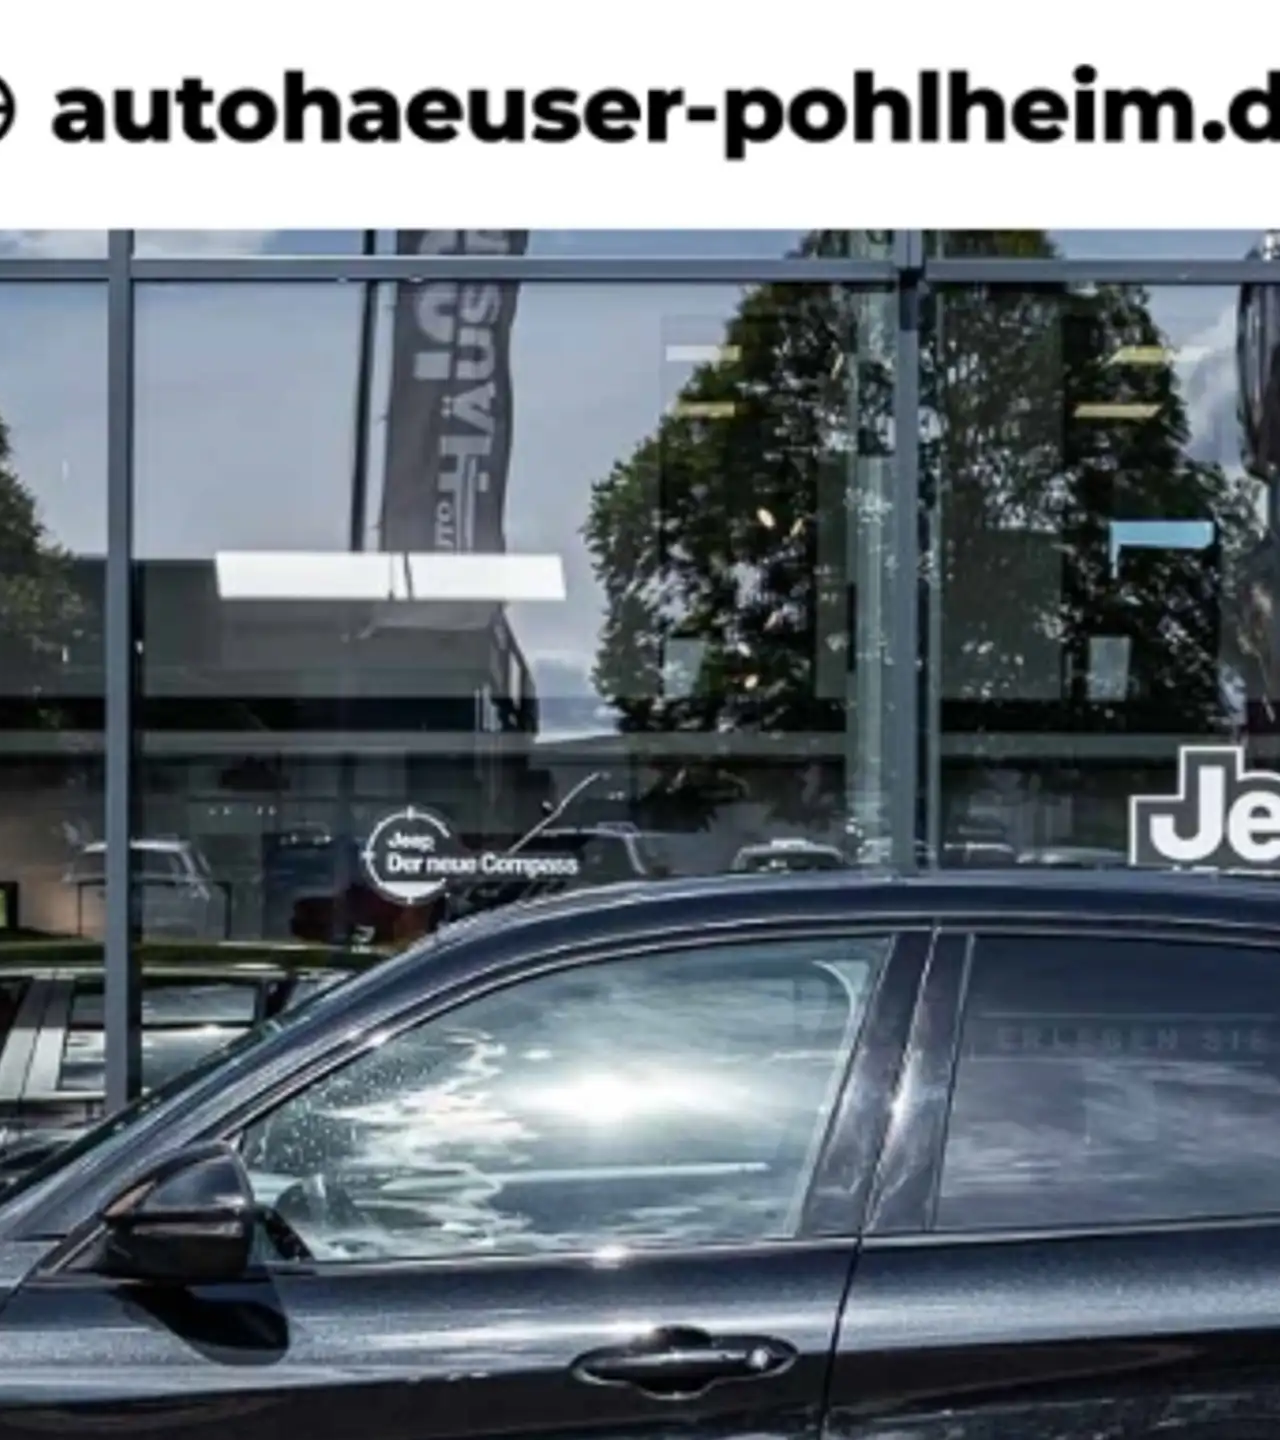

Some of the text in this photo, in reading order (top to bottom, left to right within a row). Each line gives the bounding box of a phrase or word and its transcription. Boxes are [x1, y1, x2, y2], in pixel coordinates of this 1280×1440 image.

[386, 853, 579, 876] Der neue Compass
